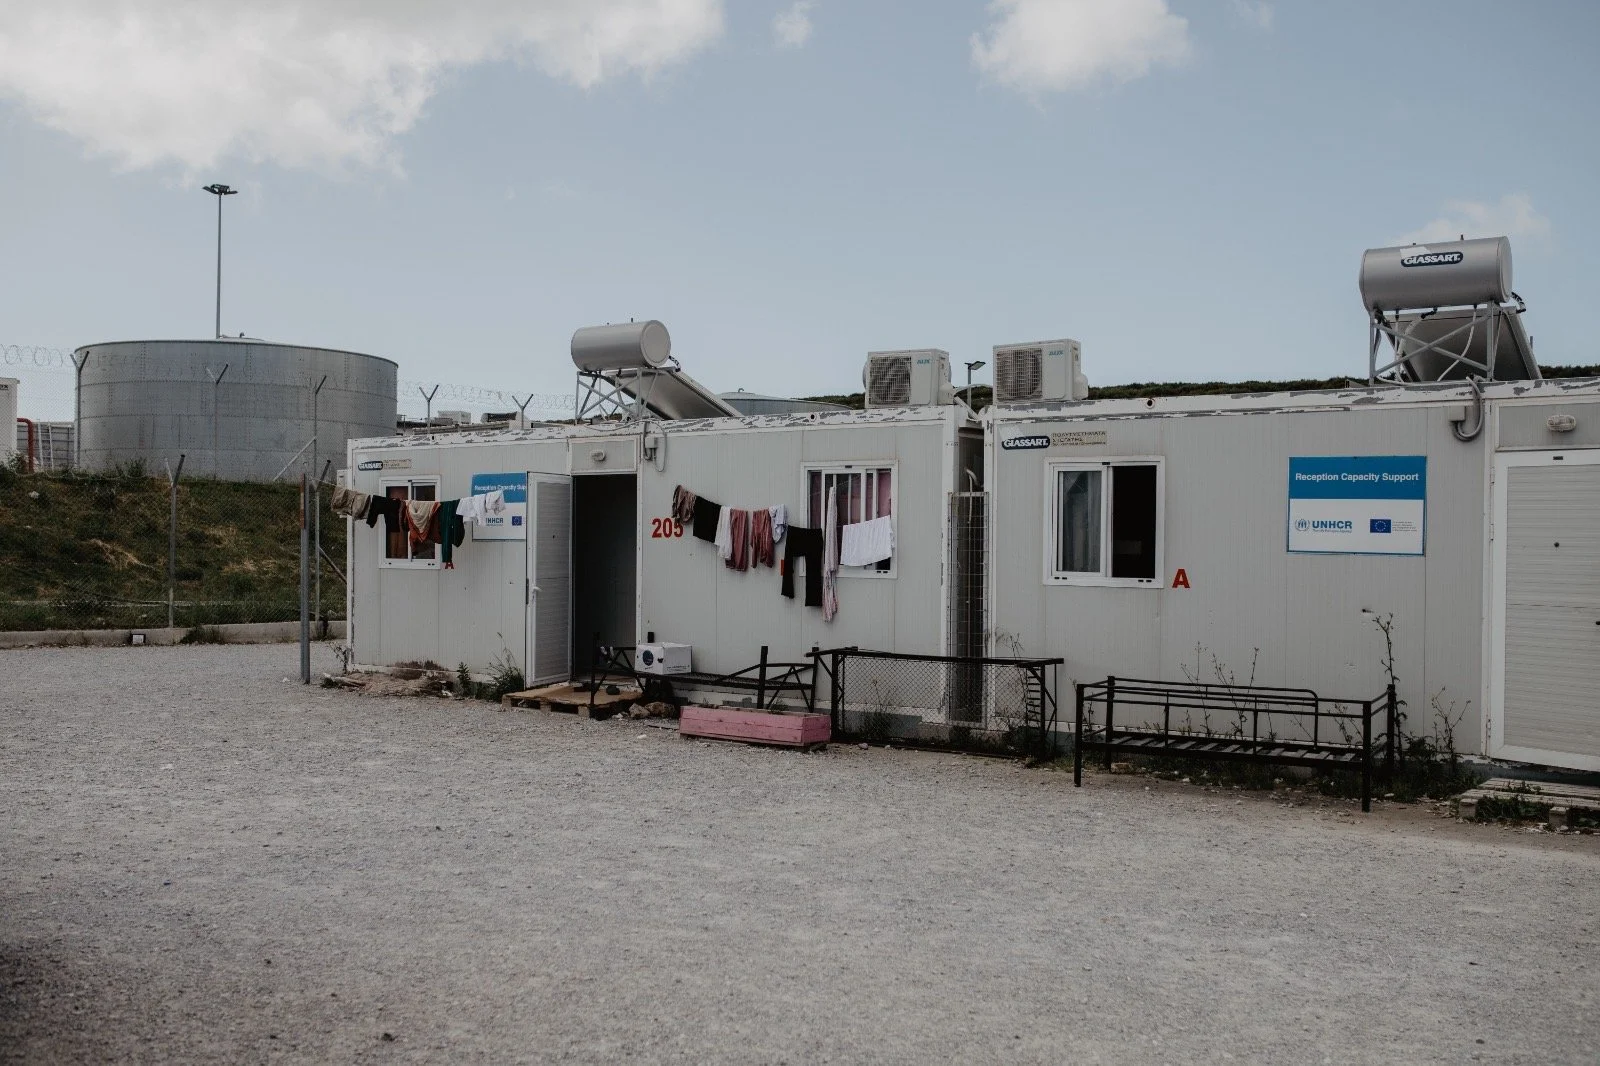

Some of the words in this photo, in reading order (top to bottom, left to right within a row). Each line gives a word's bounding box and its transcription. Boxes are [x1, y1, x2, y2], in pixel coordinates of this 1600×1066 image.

[1295, 473, 1339, 482] Reception
[1341, 473, 1379, 483] Capacity
[1382, 473, 1419, 482] Support
[1312, 520, 1352, 529] UNHCR
[1172, 569, 1191, 589] A
